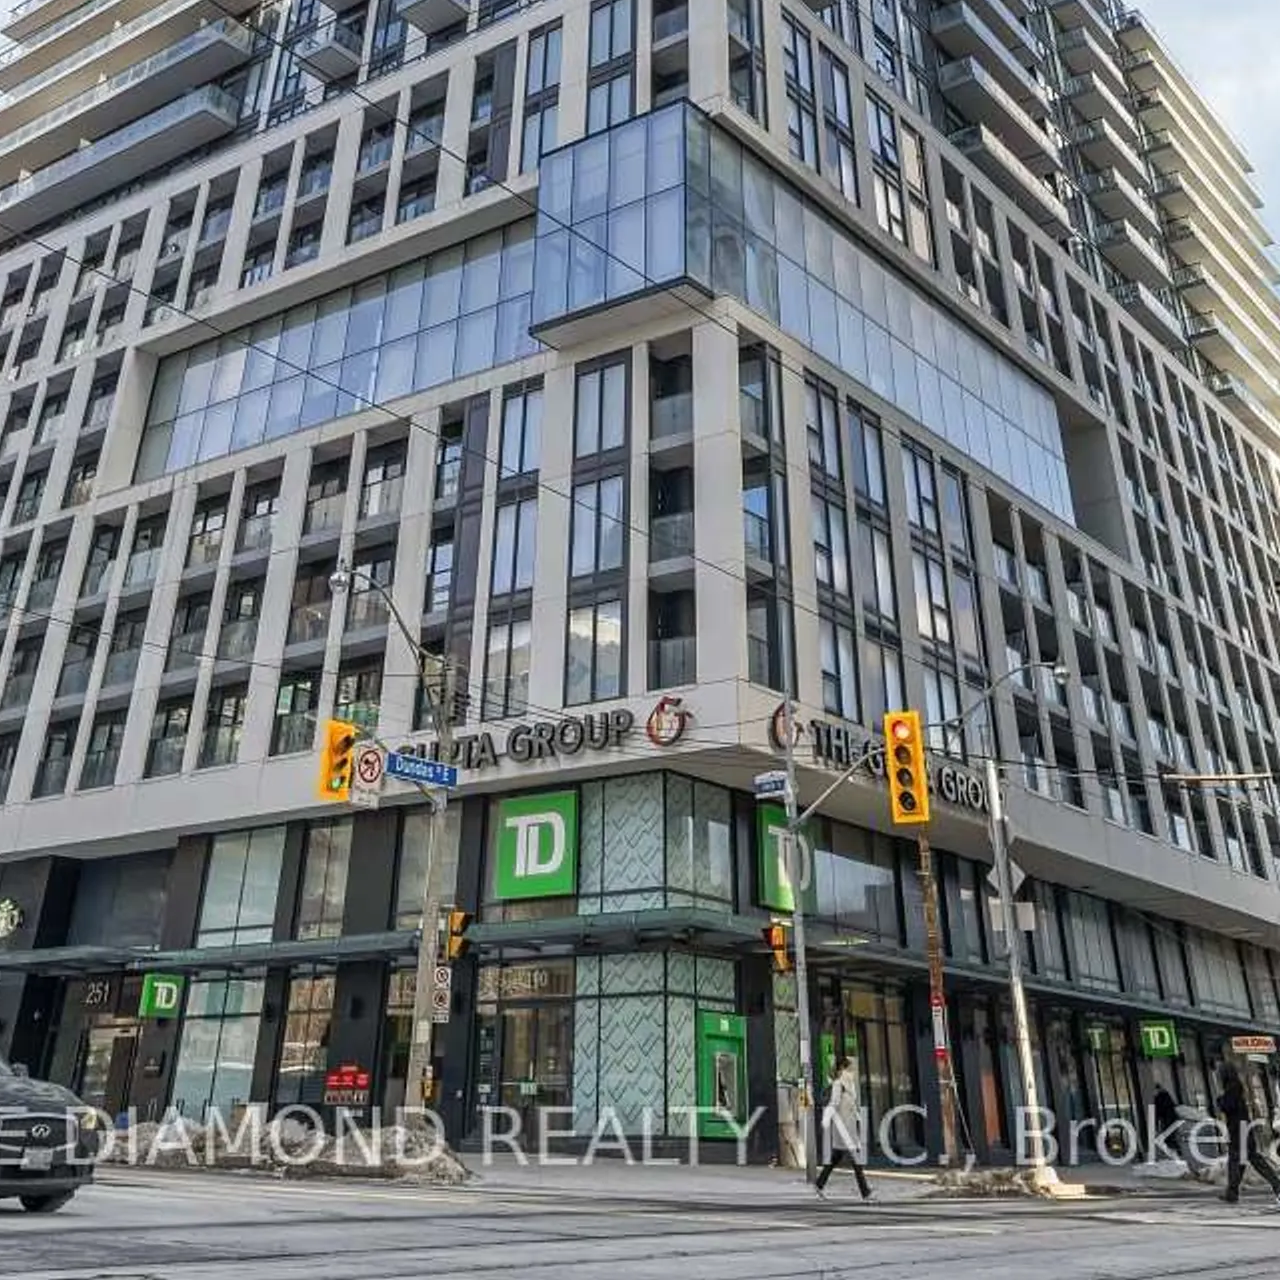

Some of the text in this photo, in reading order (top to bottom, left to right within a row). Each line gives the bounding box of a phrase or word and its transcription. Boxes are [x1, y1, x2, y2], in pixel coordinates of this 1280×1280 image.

[506, 708, 634, 763] GROUP
[505, 811, 567, 878] TD
[85, 980, 110, 1005] 251
[152, 981, 178, 1009] TD
[1143, 1025, 1171, 1050] TD
